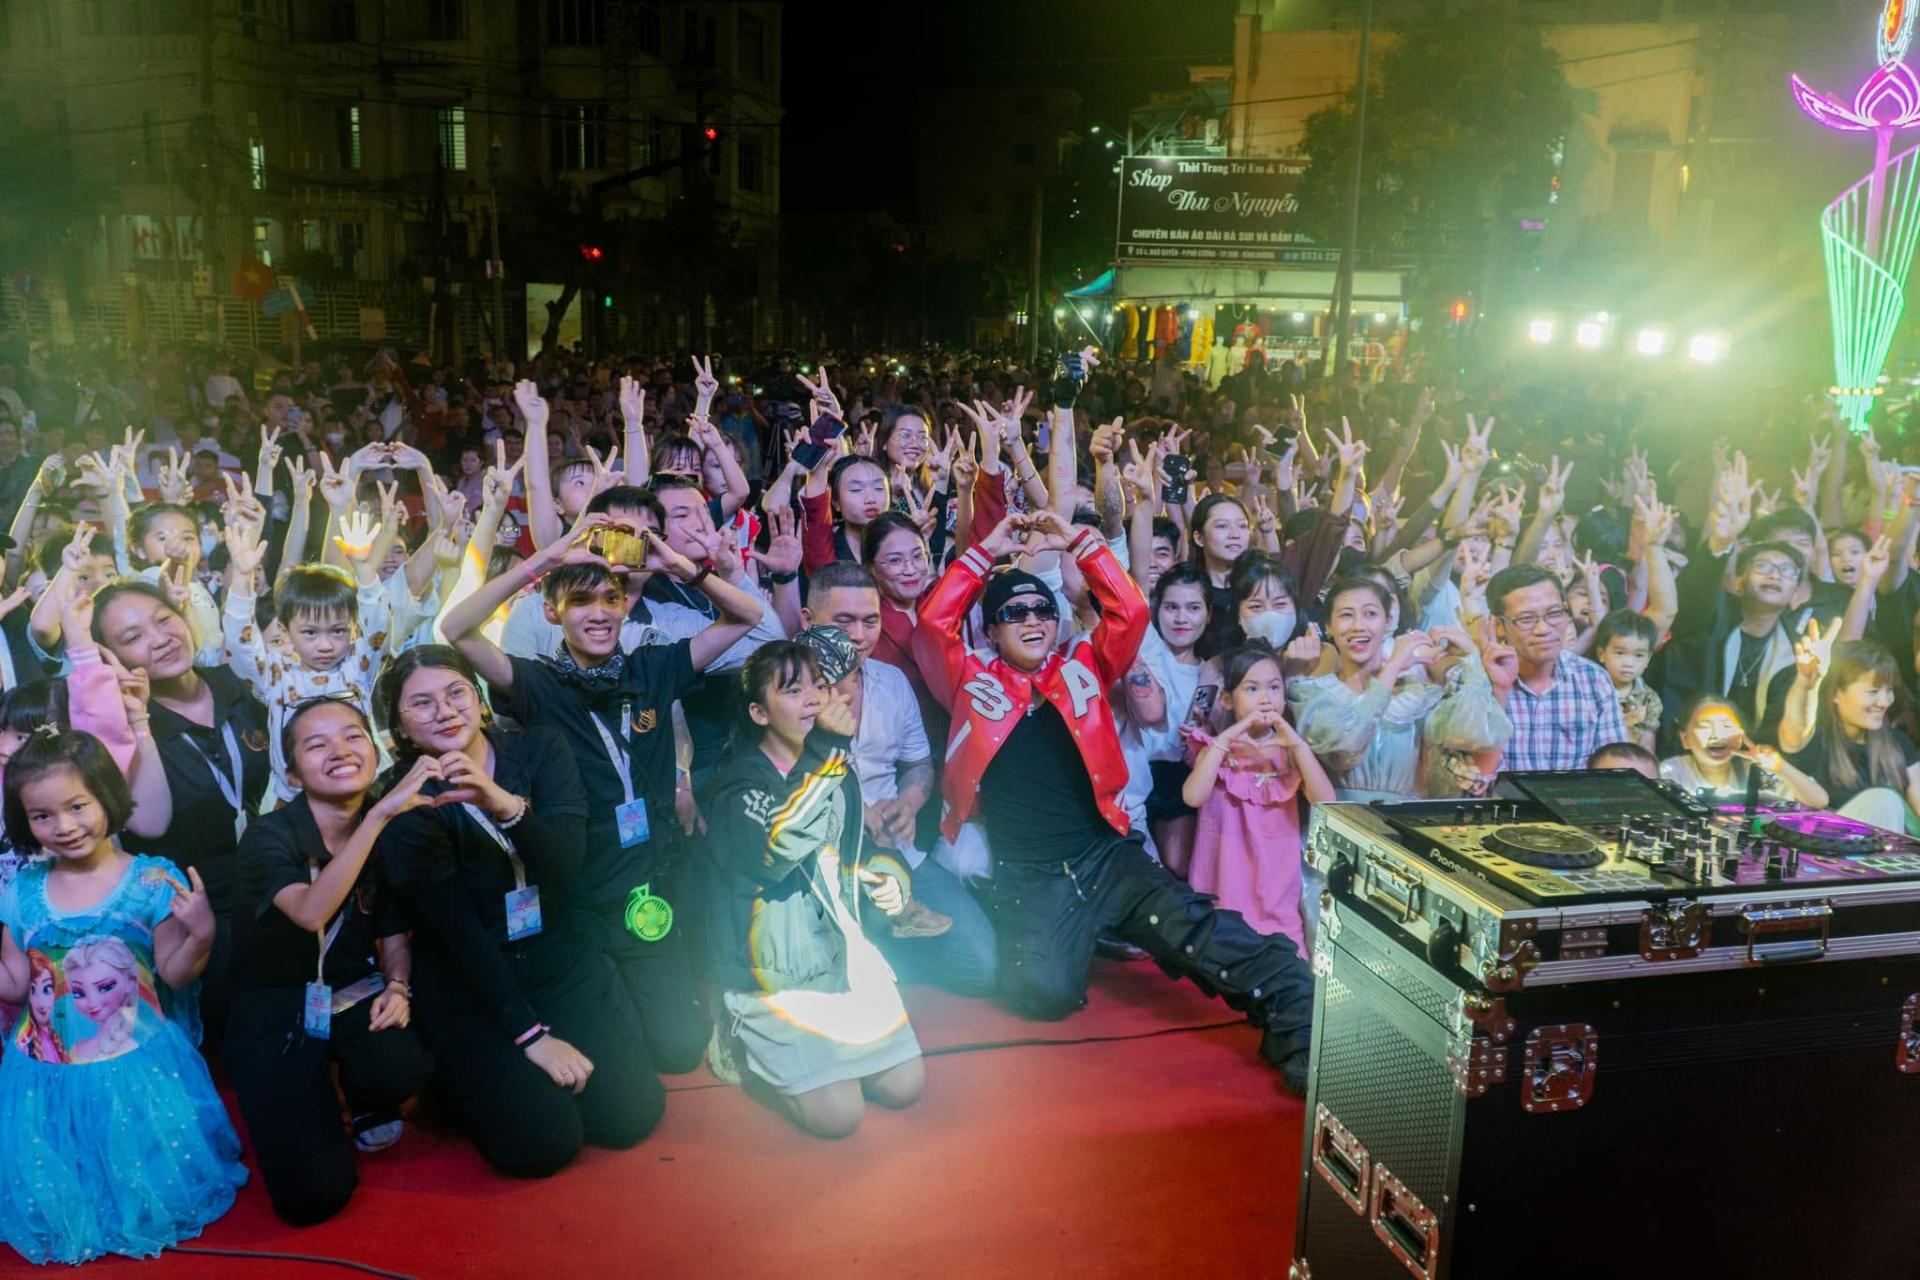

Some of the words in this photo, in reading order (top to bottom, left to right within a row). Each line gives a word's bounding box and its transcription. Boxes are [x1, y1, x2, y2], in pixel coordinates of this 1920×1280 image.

[1129, 168, 1172, 192] Shop
[1202, 162, 1229, 175] Trang
[1248, 164, 1264, 173] Em
[1266, 164, 1275, 174] &
[1168, 189, 1210, 211] Thu
[1132, 229, 1168, 240] CHUYÊN
[1170, 230, 1189, 240] BÁN
[1191, 230, 1204, 240] ÁO
[1256, 231, 1269, 242] VÀ
[964, 672, 1013, 721] 23
[1060, 659, 1100, 719] A
[1429, 848, 1473, 877] Pione
